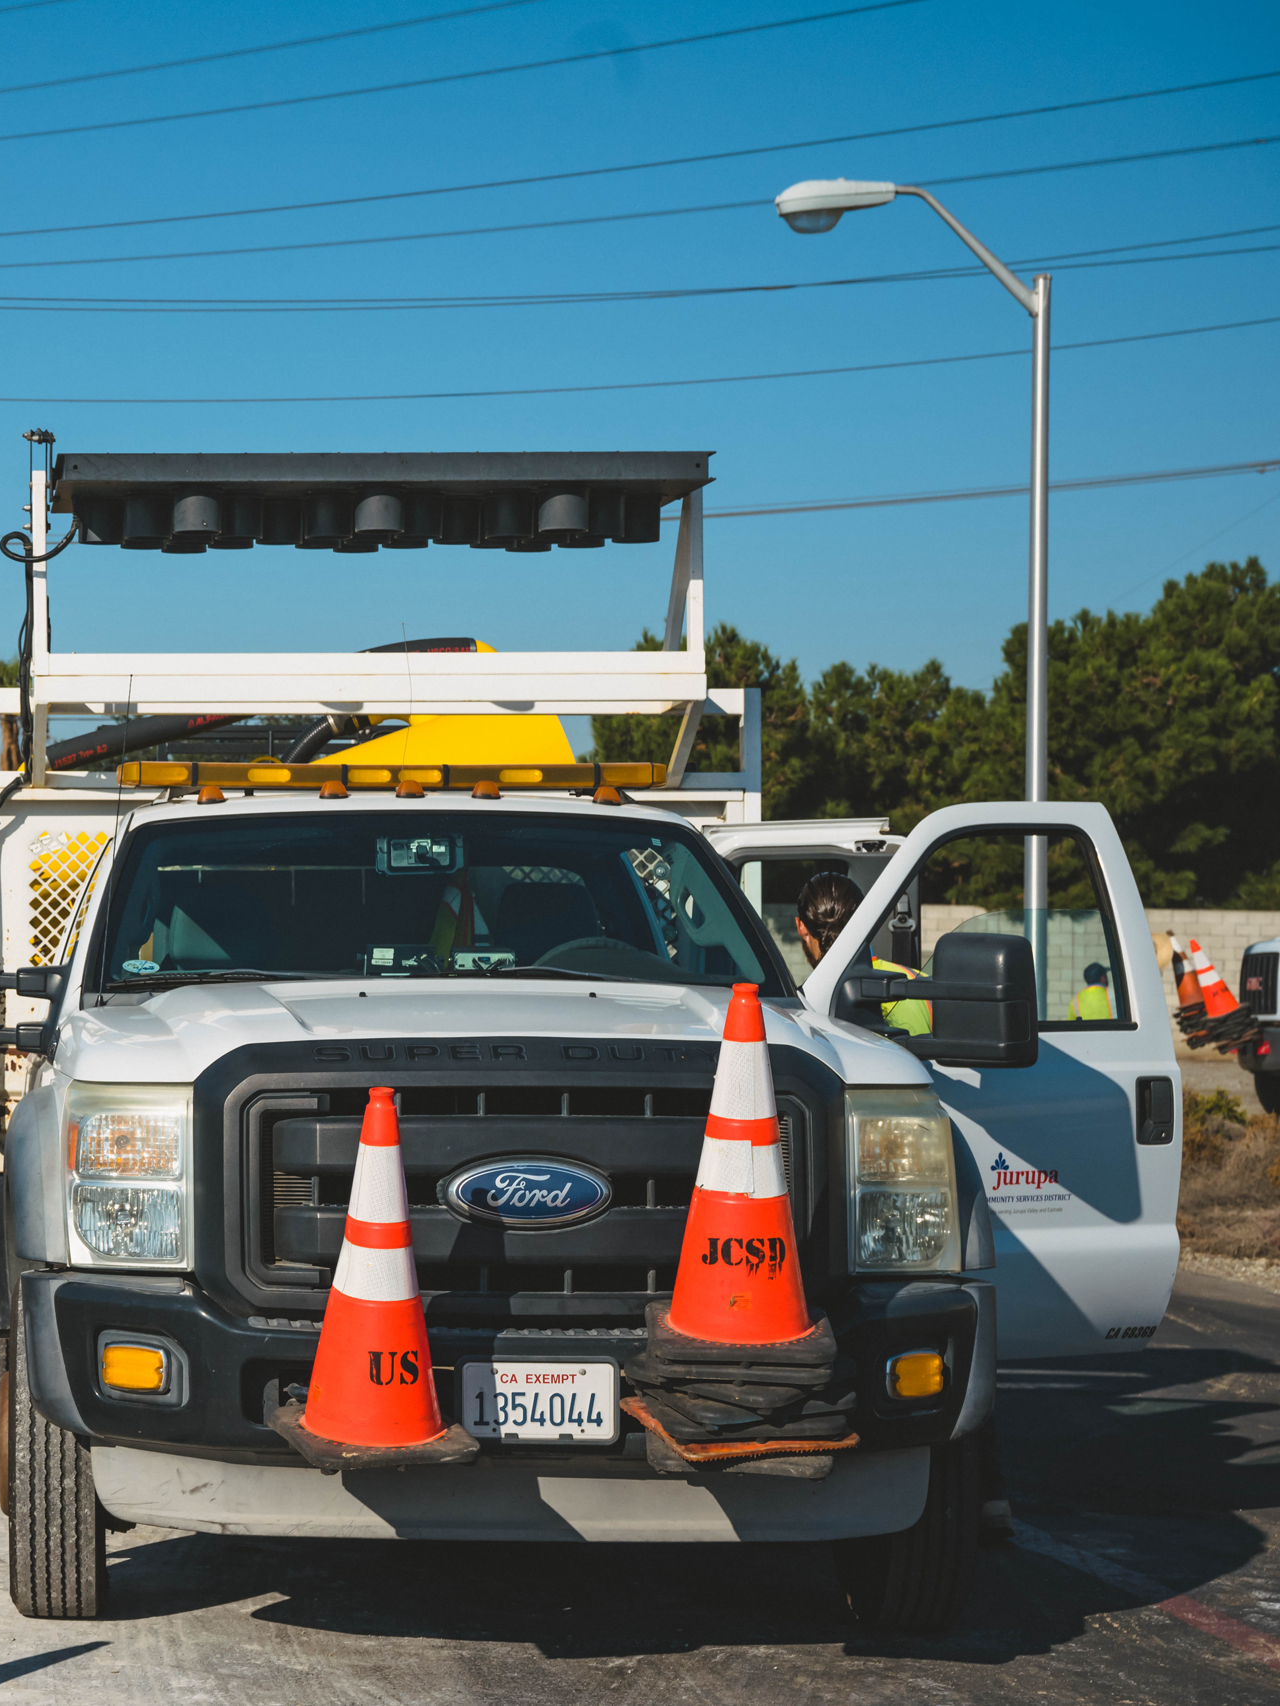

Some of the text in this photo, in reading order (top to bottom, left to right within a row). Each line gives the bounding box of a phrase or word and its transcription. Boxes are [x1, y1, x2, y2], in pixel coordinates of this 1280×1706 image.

[312, 1043, 719, 1063] SUPER DUTY
[486, 1172, 572, 1208] Ford
[992, 1169, 1059, 1191] jurupa
[1015, 1194, 1043, 1203] SERVICES
[1043, 1193, 1072, 1202] DISTRICT
[701, 1237, 786, 1267] JCSD
[1105, 1327, 1121, 1340] CA
[367, 1350, 420, 1386] US
[500, 1373, 577, 1384] CA EXEMPT
[473, 1391, 604, 1427] 1354044
